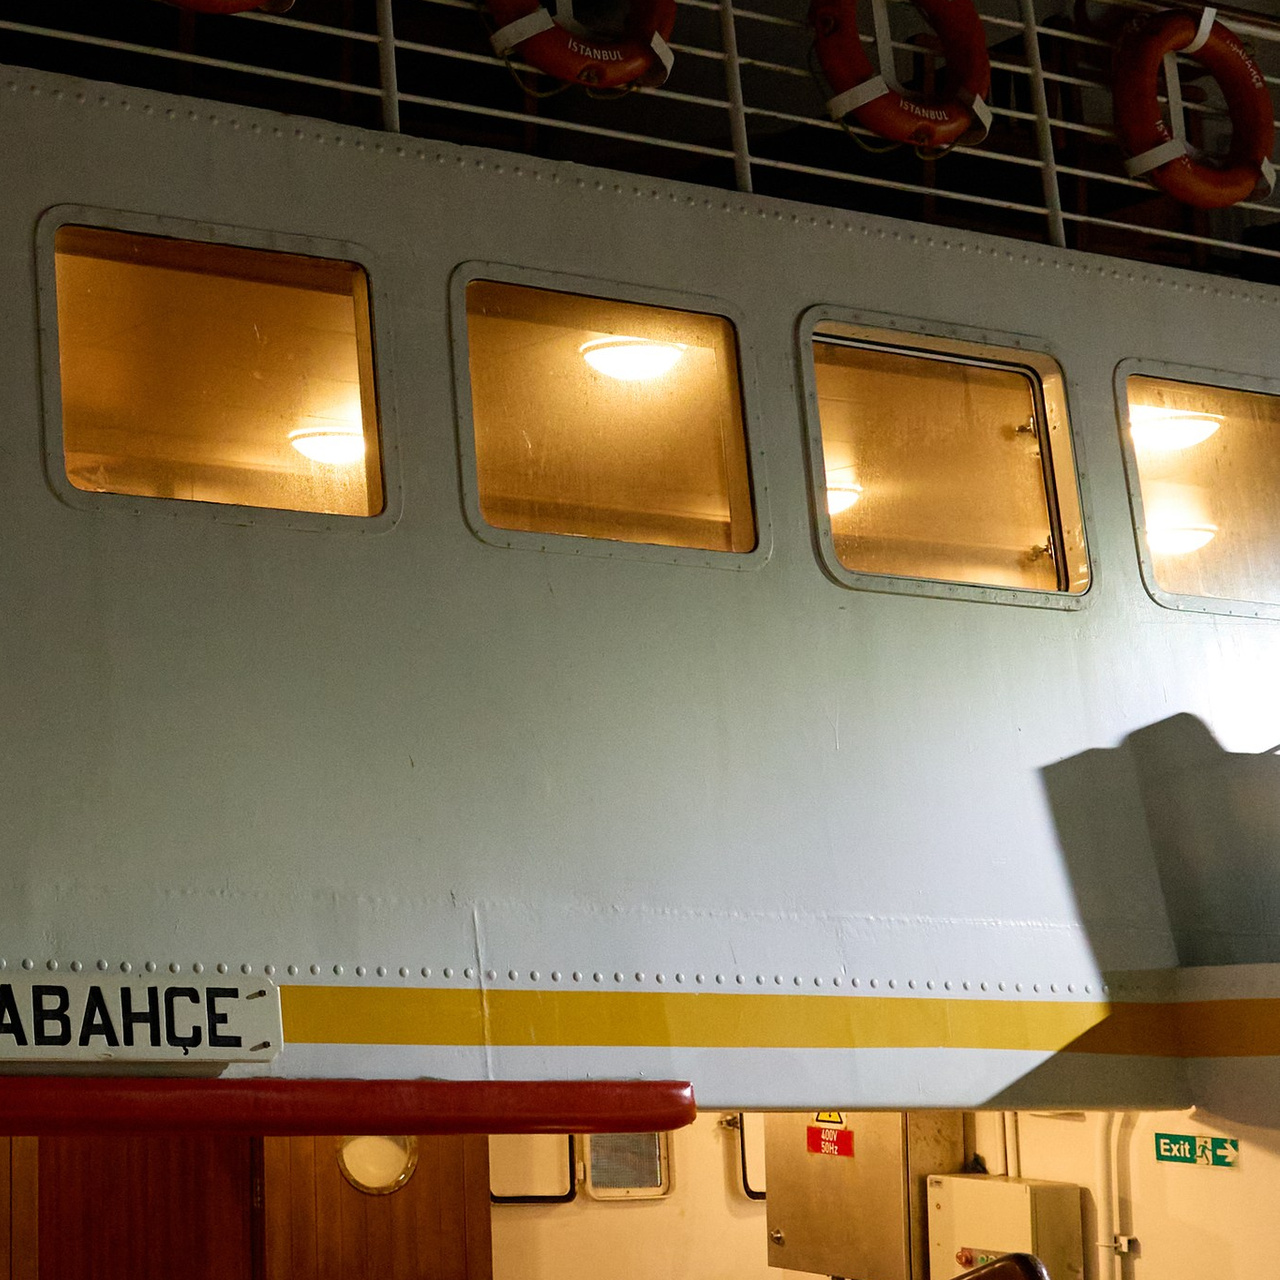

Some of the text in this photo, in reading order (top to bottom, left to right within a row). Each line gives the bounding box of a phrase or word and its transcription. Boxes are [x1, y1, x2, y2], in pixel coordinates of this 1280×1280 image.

[821, 1129, 838, 1142] 400V
[821, 1141, 838, 1155] 50Hz
[1160, 1138, 1191, 1158] Exit
